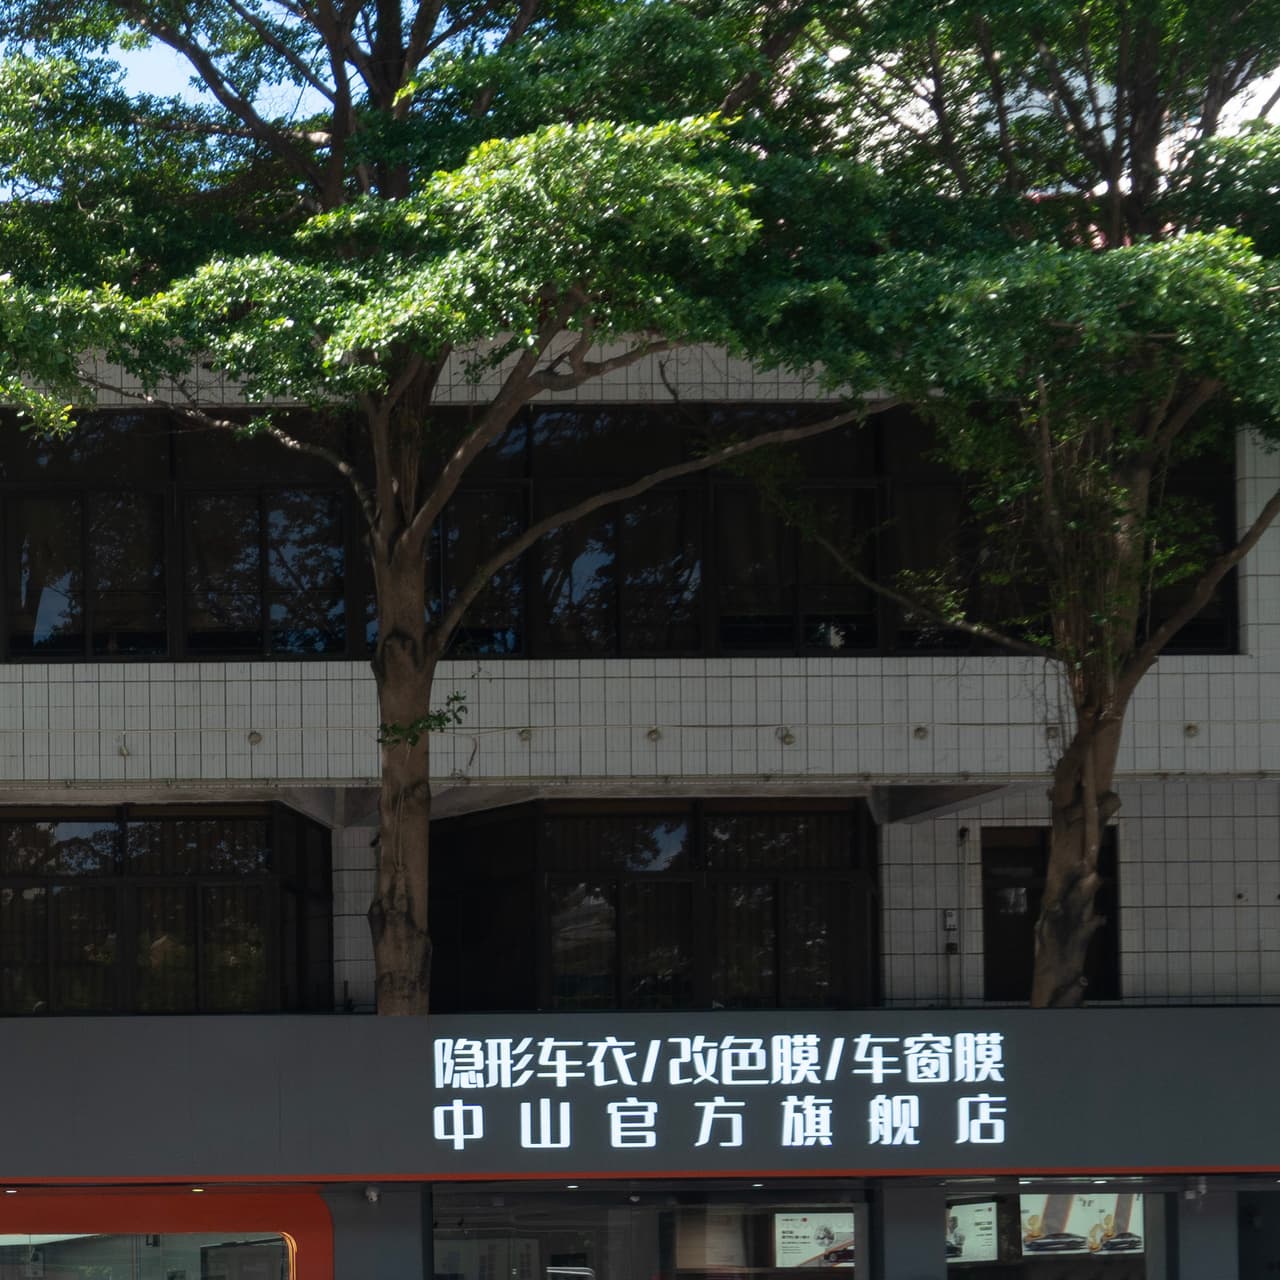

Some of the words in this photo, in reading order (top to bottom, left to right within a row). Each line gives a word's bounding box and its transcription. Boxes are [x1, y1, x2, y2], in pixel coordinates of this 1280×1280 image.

[434, 1032, 1005, 1089] 隐形车衣/改色膜/车窗膜
[433, 1093, 1007, 1150] 中山官方旗舰店
